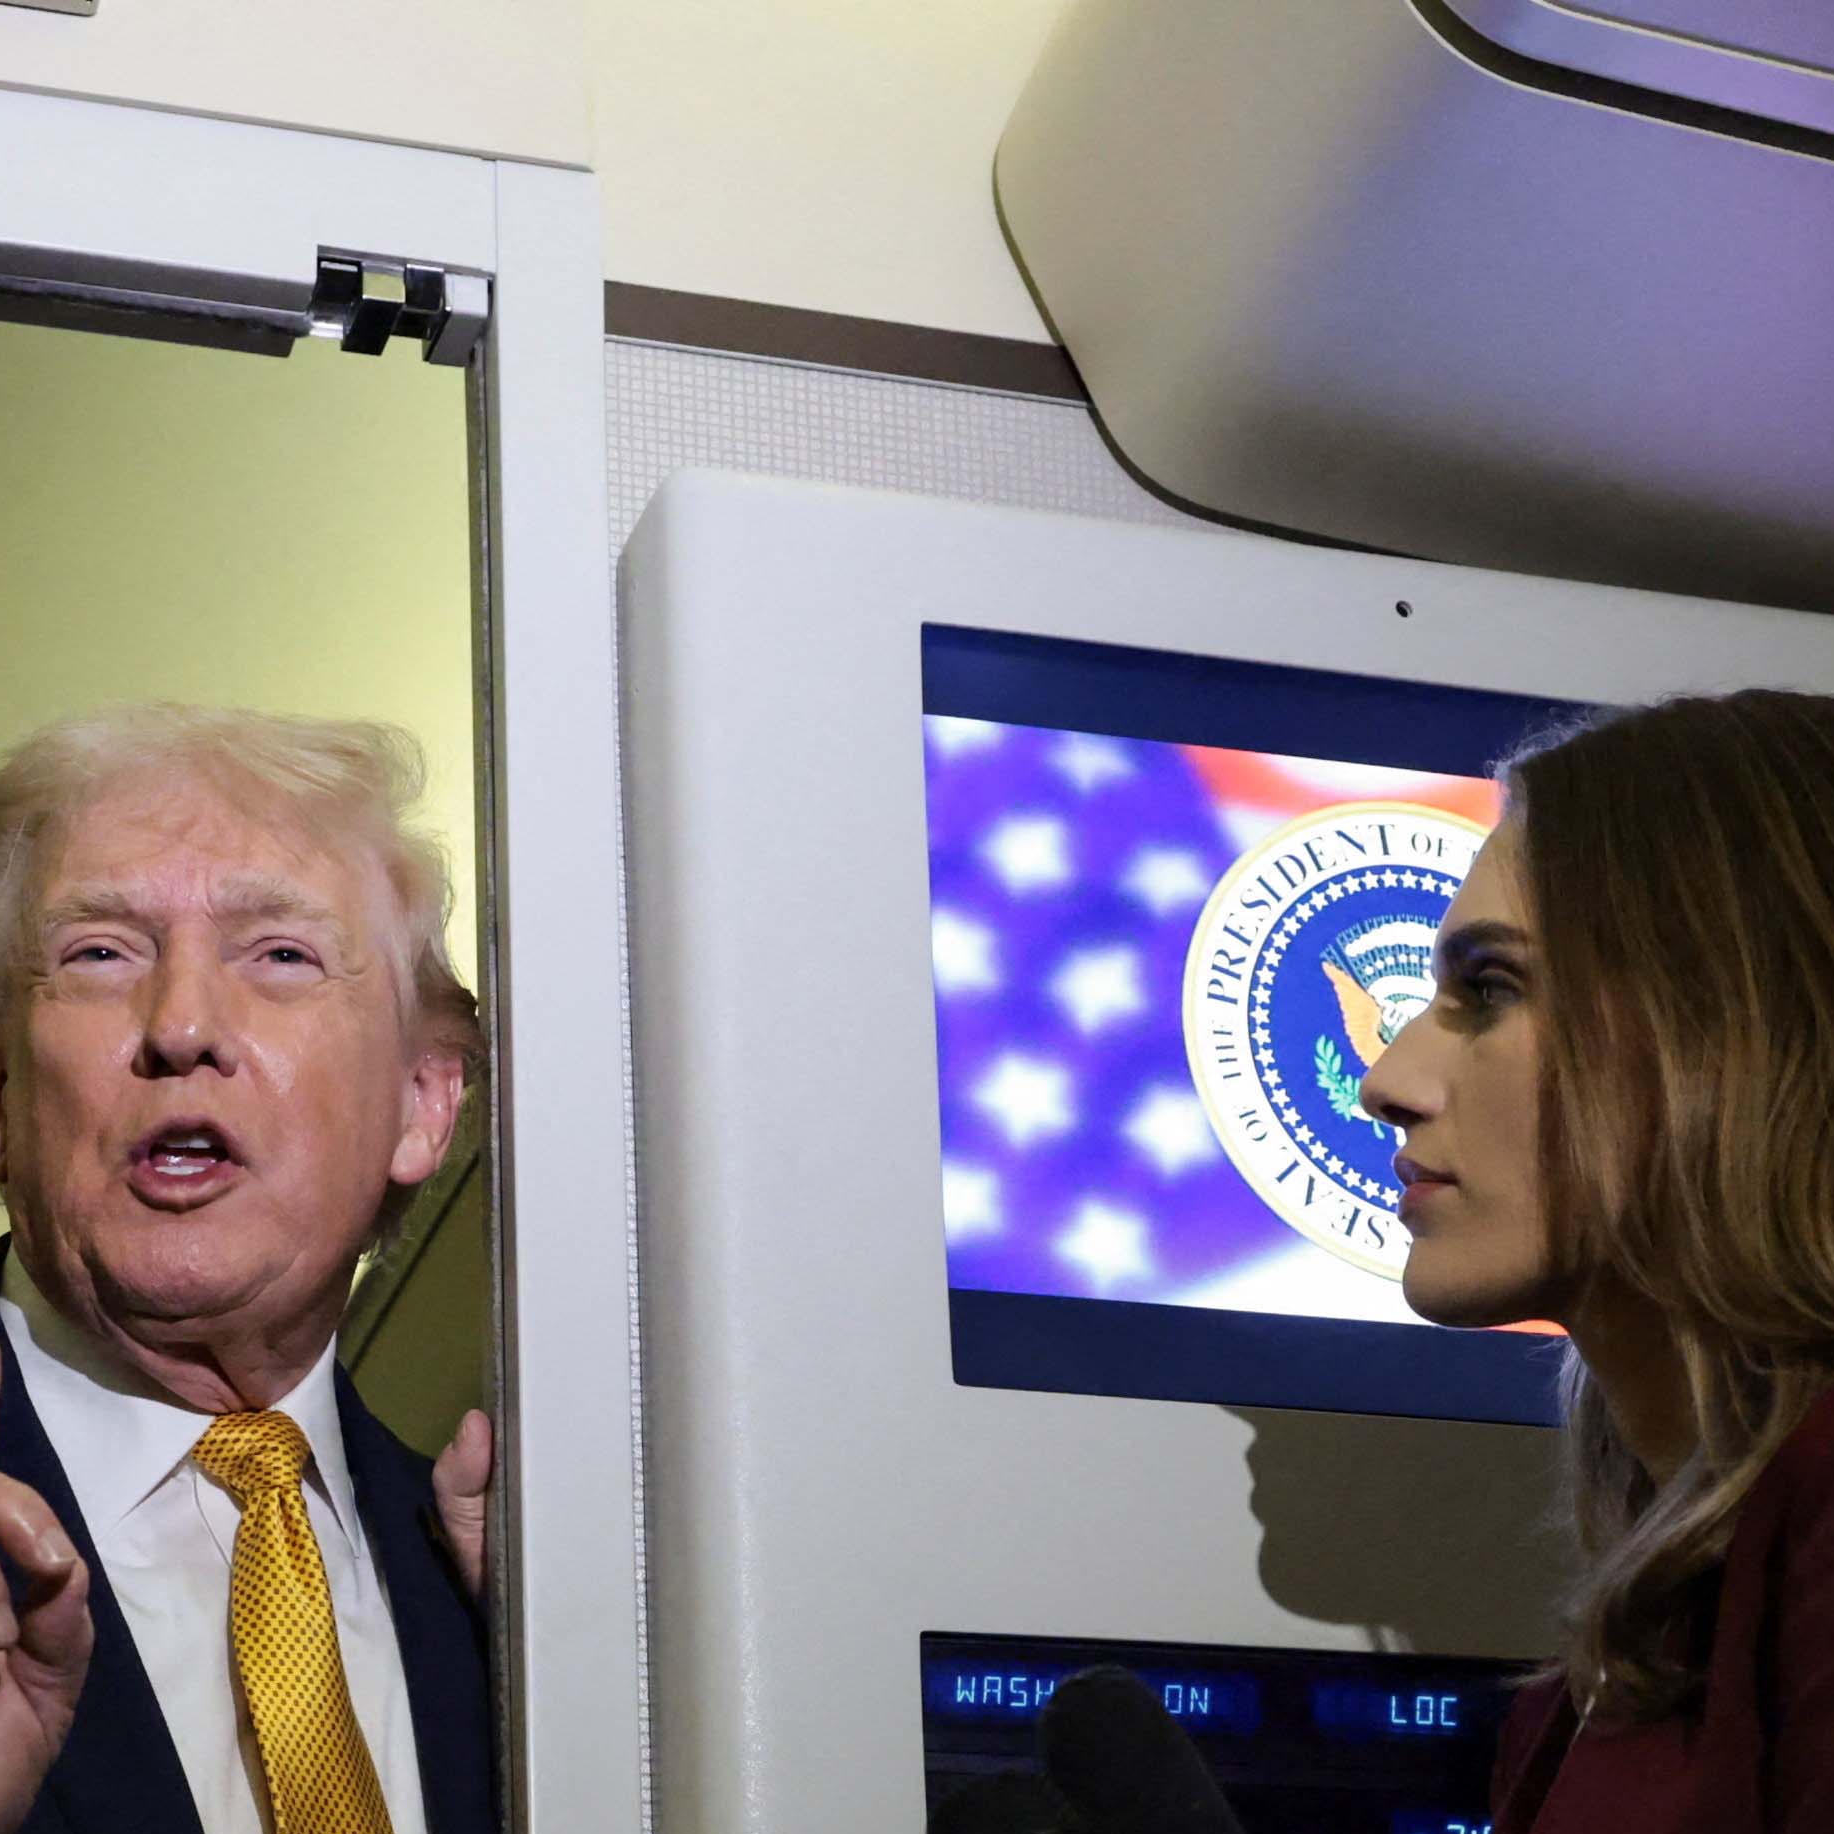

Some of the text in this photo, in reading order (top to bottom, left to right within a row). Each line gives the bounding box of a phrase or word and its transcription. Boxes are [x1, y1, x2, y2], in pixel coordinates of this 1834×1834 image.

[1206, 823, 1455, 1250] SEAL OF THE PRESIDENT OF
[956, 1675, 1209, 1715] WASHON
[1391, 1695, 1457, 1726] LOC
